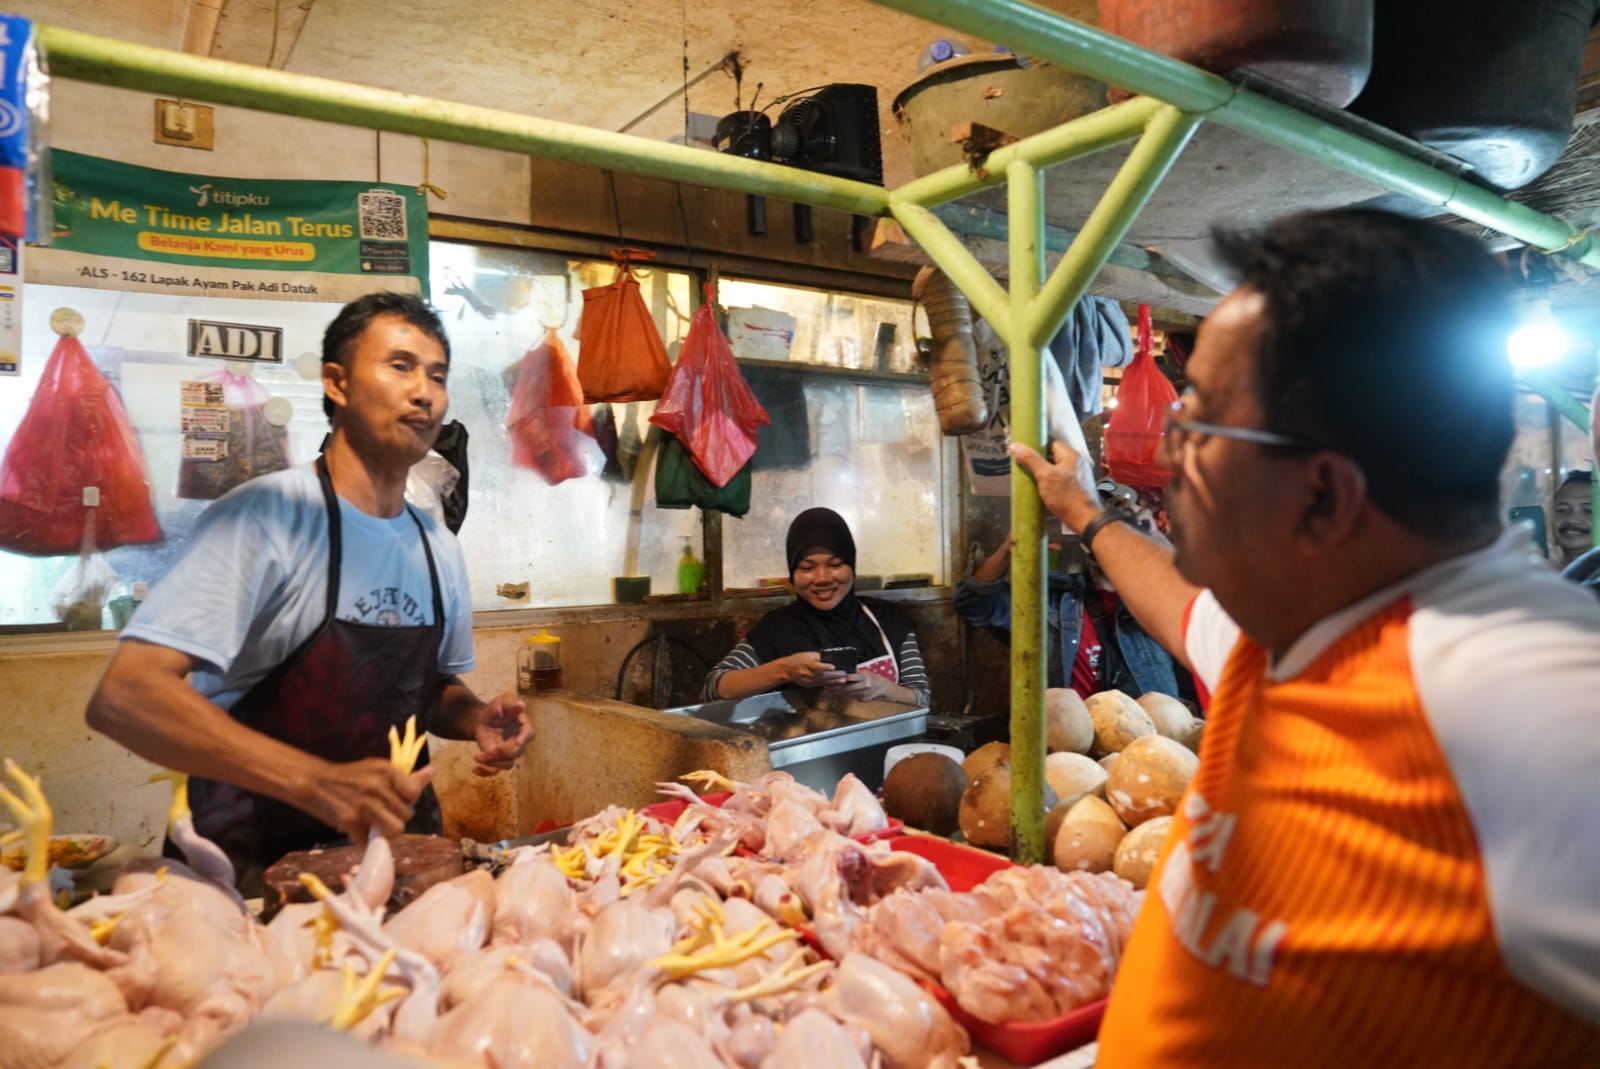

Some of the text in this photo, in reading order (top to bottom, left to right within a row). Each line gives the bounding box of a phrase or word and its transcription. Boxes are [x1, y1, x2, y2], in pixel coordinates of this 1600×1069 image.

[212, 190, 271, 207] titipku
[90, 197, 353, 238] Me Time Jalan Terus
[150, 235, 305, 257] Belanja Kami yang Urus
[80, 265, 109, 279] ALS
[121, 270, 147, 283] 162
[150, 273, 189, 287] Lapak
[192, 278, 229, 290] Ayam
[232, 280, 255, 292] Pak
[258, 282, 279, 293] Adi
[281, 282, 318, 295] Datuk
[197, 324, 278, 360] ADI
